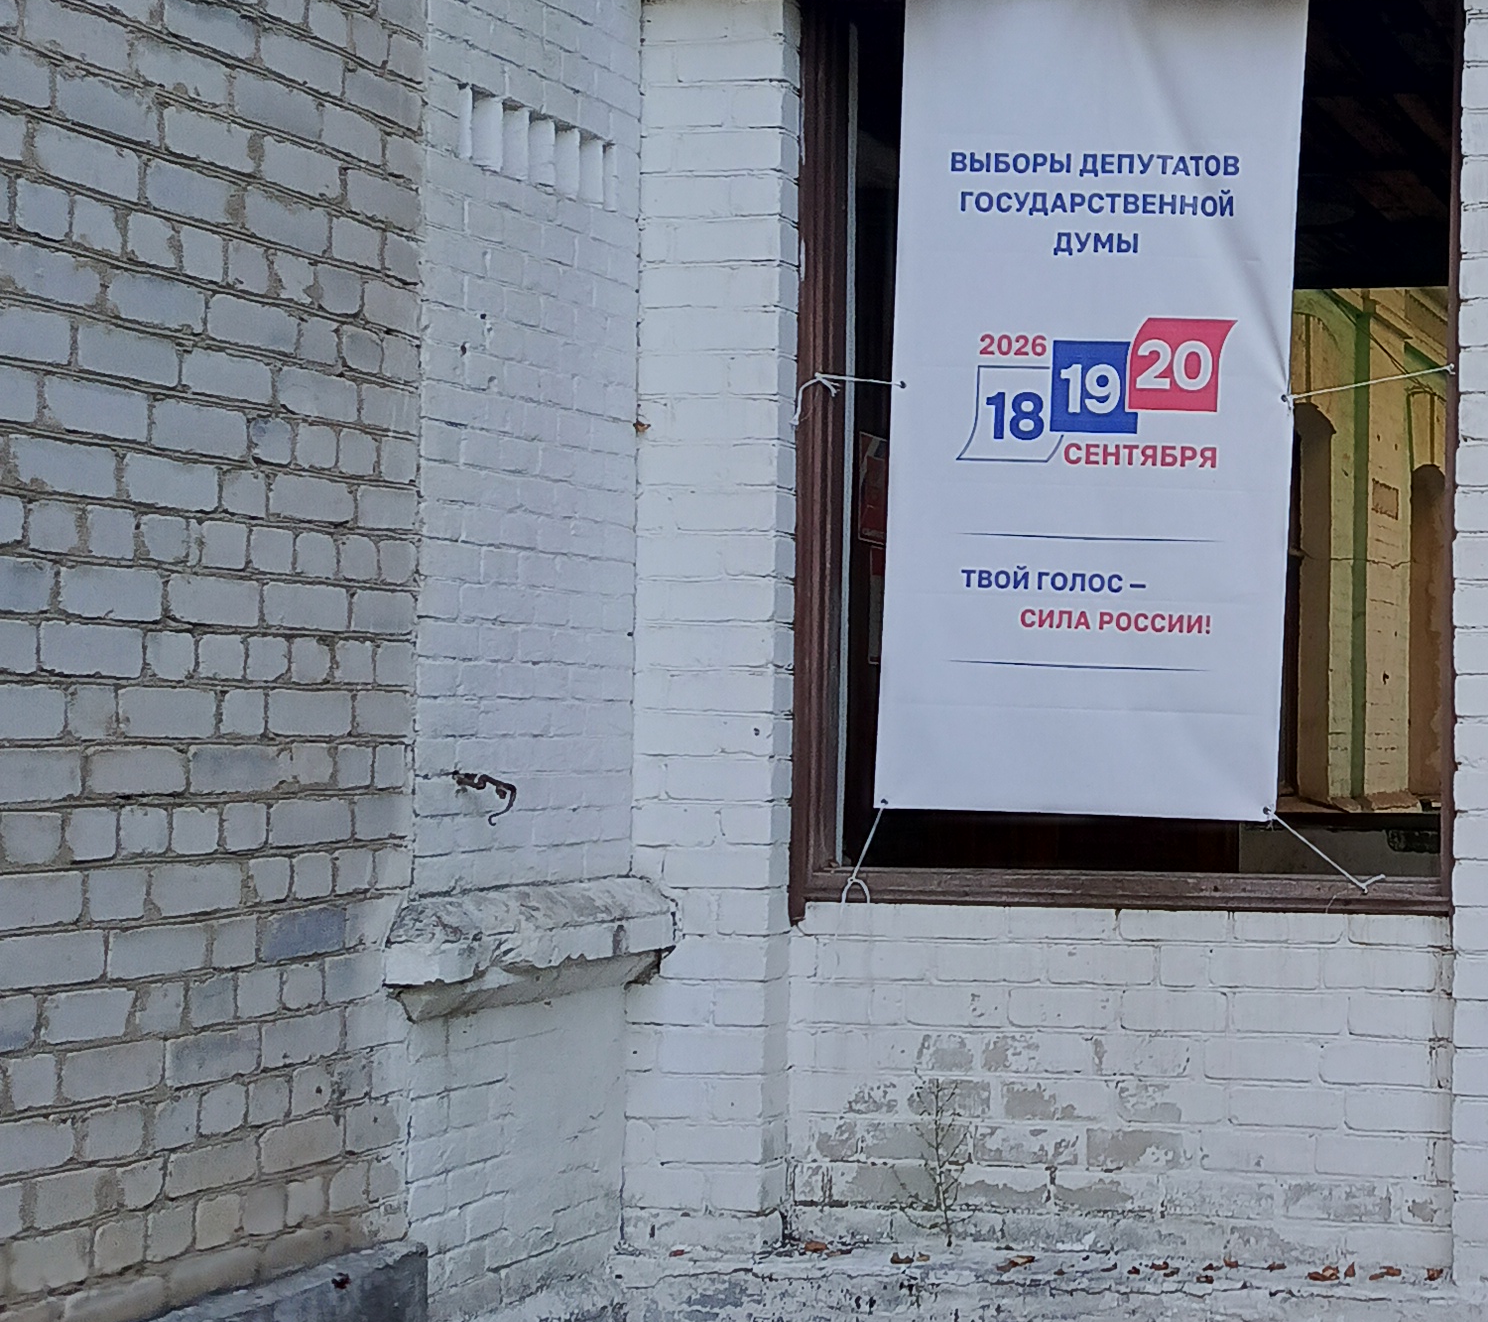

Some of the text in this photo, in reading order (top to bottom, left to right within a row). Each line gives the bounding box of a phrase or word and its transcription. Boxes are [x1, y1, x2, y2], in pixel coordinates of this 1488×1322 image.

[950, 151, 1240, 178] ВЫБОРЫ ДЕПУТАТОВ
[960, 189, 1234, 218] ГОСУДАРСТВЕННОЙ
[1053, 231, 1139, 257] ДУМЫ
[979, 333, 1047, 357] 2026
[985, 339, 1213, 441] 18 19 20
[1063, 442, 1217, 469] СЕНТЯБРЯ
[960, 565, 1030, 590] ТВОЙ
[1037, 571, 1124, 594] ГОЛОС
[1020, 608, 1212, 635] СИЛА РОССИИ!
